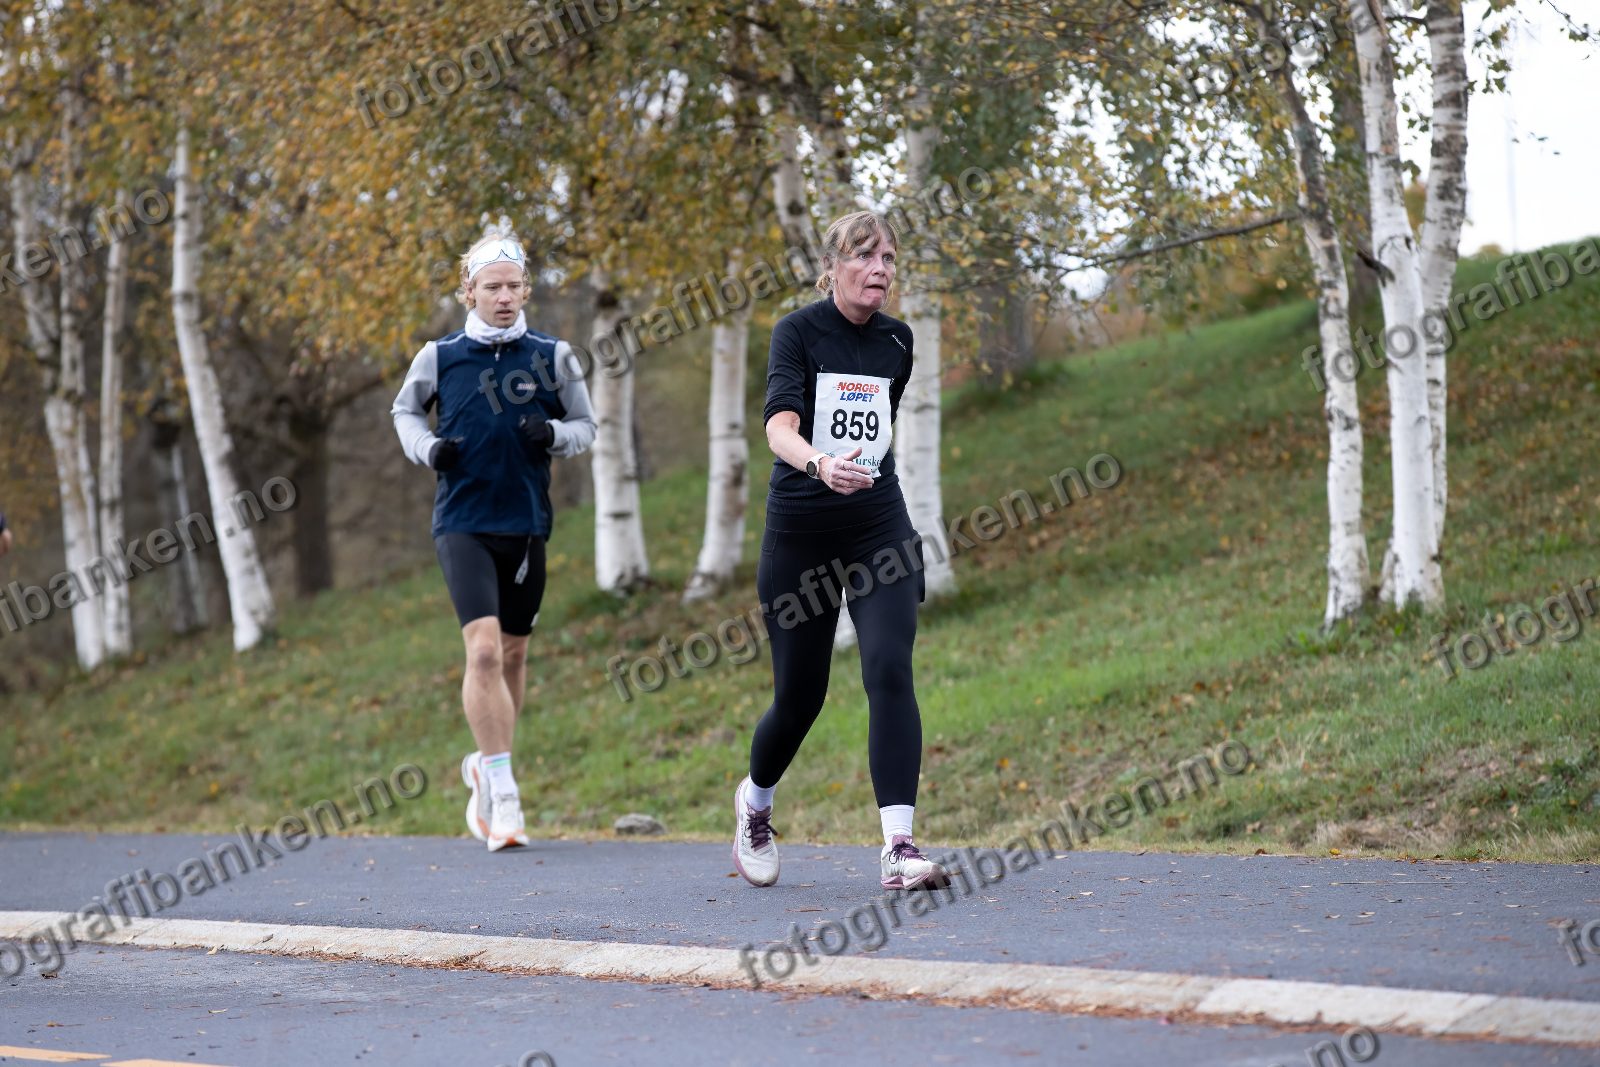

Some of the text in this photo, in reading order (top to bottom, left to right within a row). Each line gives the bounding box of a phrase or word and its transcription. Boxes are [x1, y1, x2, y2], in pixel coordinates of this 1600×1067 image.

[836, 381, 880, 393] NORGES
[839, 392, 875, 403] LØPET
[830, 408, 880, 442] 859
